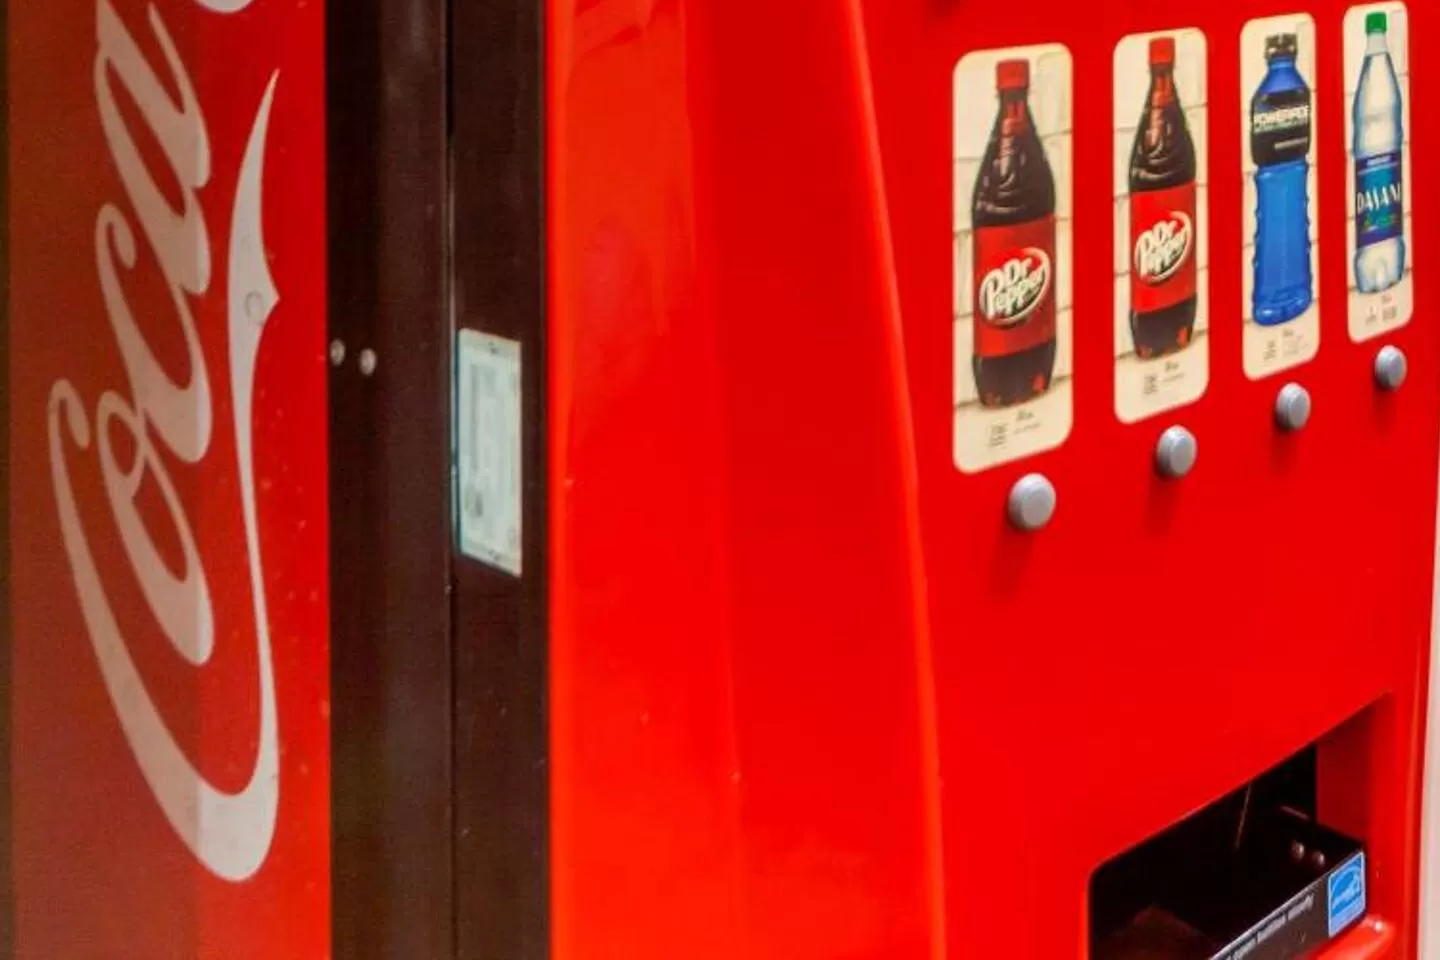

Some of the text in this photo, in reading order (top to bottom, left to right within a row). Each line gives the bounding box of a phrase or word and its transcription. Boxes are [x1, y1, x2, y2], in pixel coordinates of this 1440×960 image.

[1356, 181, 1401, 214] DASAN
[1153, 220, 1178, 248] Dr
[1003, 257, 1033, 287] Dr
[980, 267, 1046, 319] Pepper
